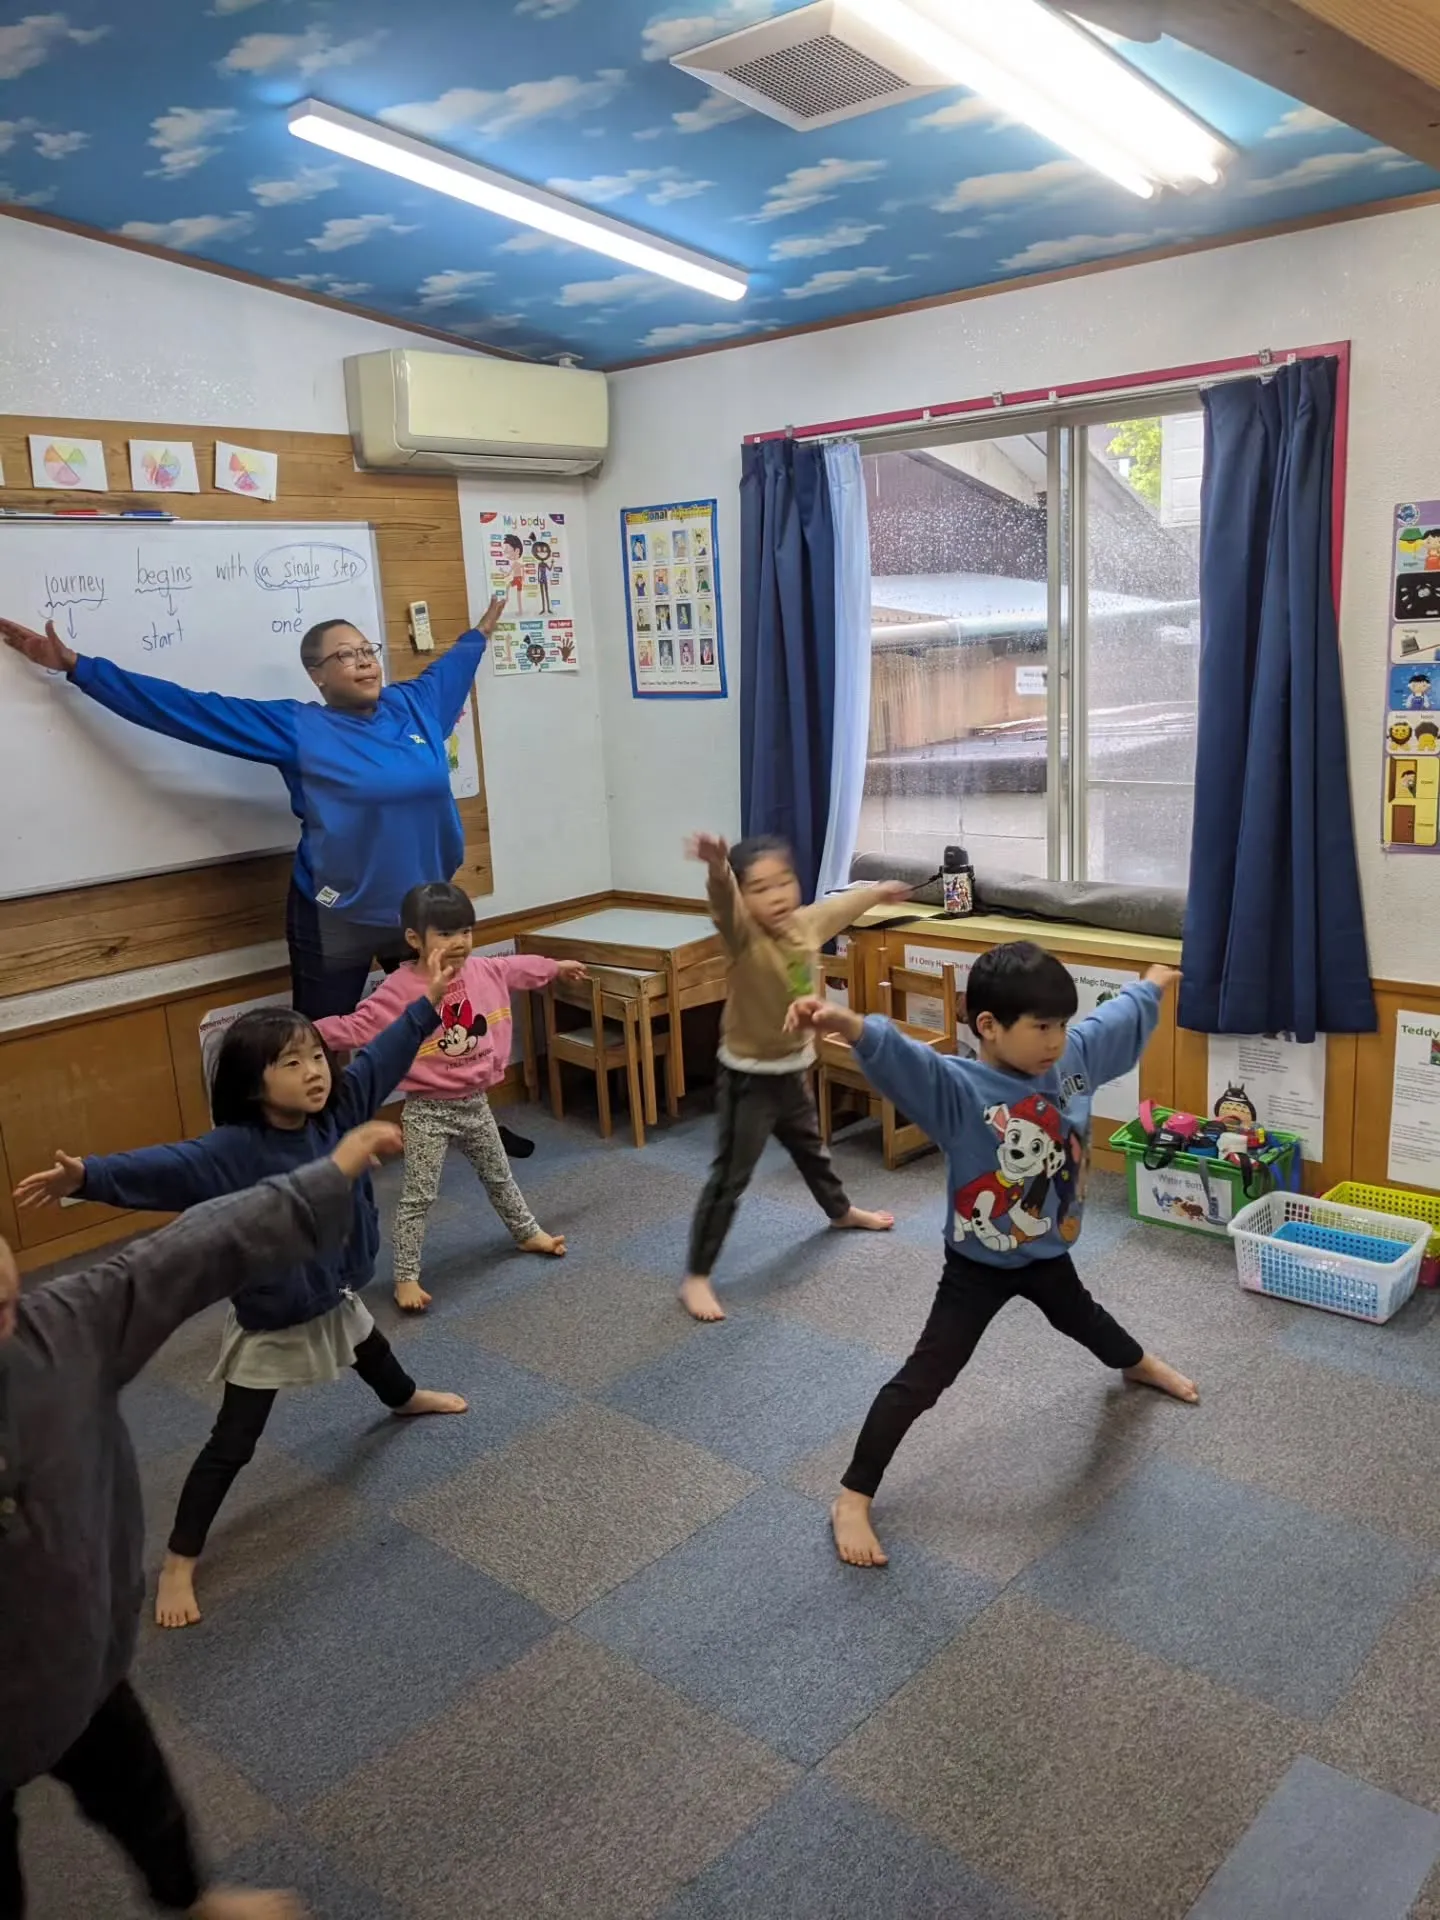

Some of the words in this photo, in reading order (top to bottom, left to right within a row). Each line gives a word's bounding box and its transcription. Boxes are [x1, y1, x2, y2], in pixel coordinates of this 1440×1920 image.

[503, 514, 517, 529] My
[520, 513, 545, 530] body
[38, 572, 105, 619] journey
[137, 546, 192, 598] begins
[216, 551, 249, 581] with
[261, 565, 273, 578] a
[284, 545, 320, 591] single
[333, 547, 358, 584] step
[271, 617, 303, 634] one
[142, 618, 185, 651] start
[1080, 976, 1099, 987] Magic
